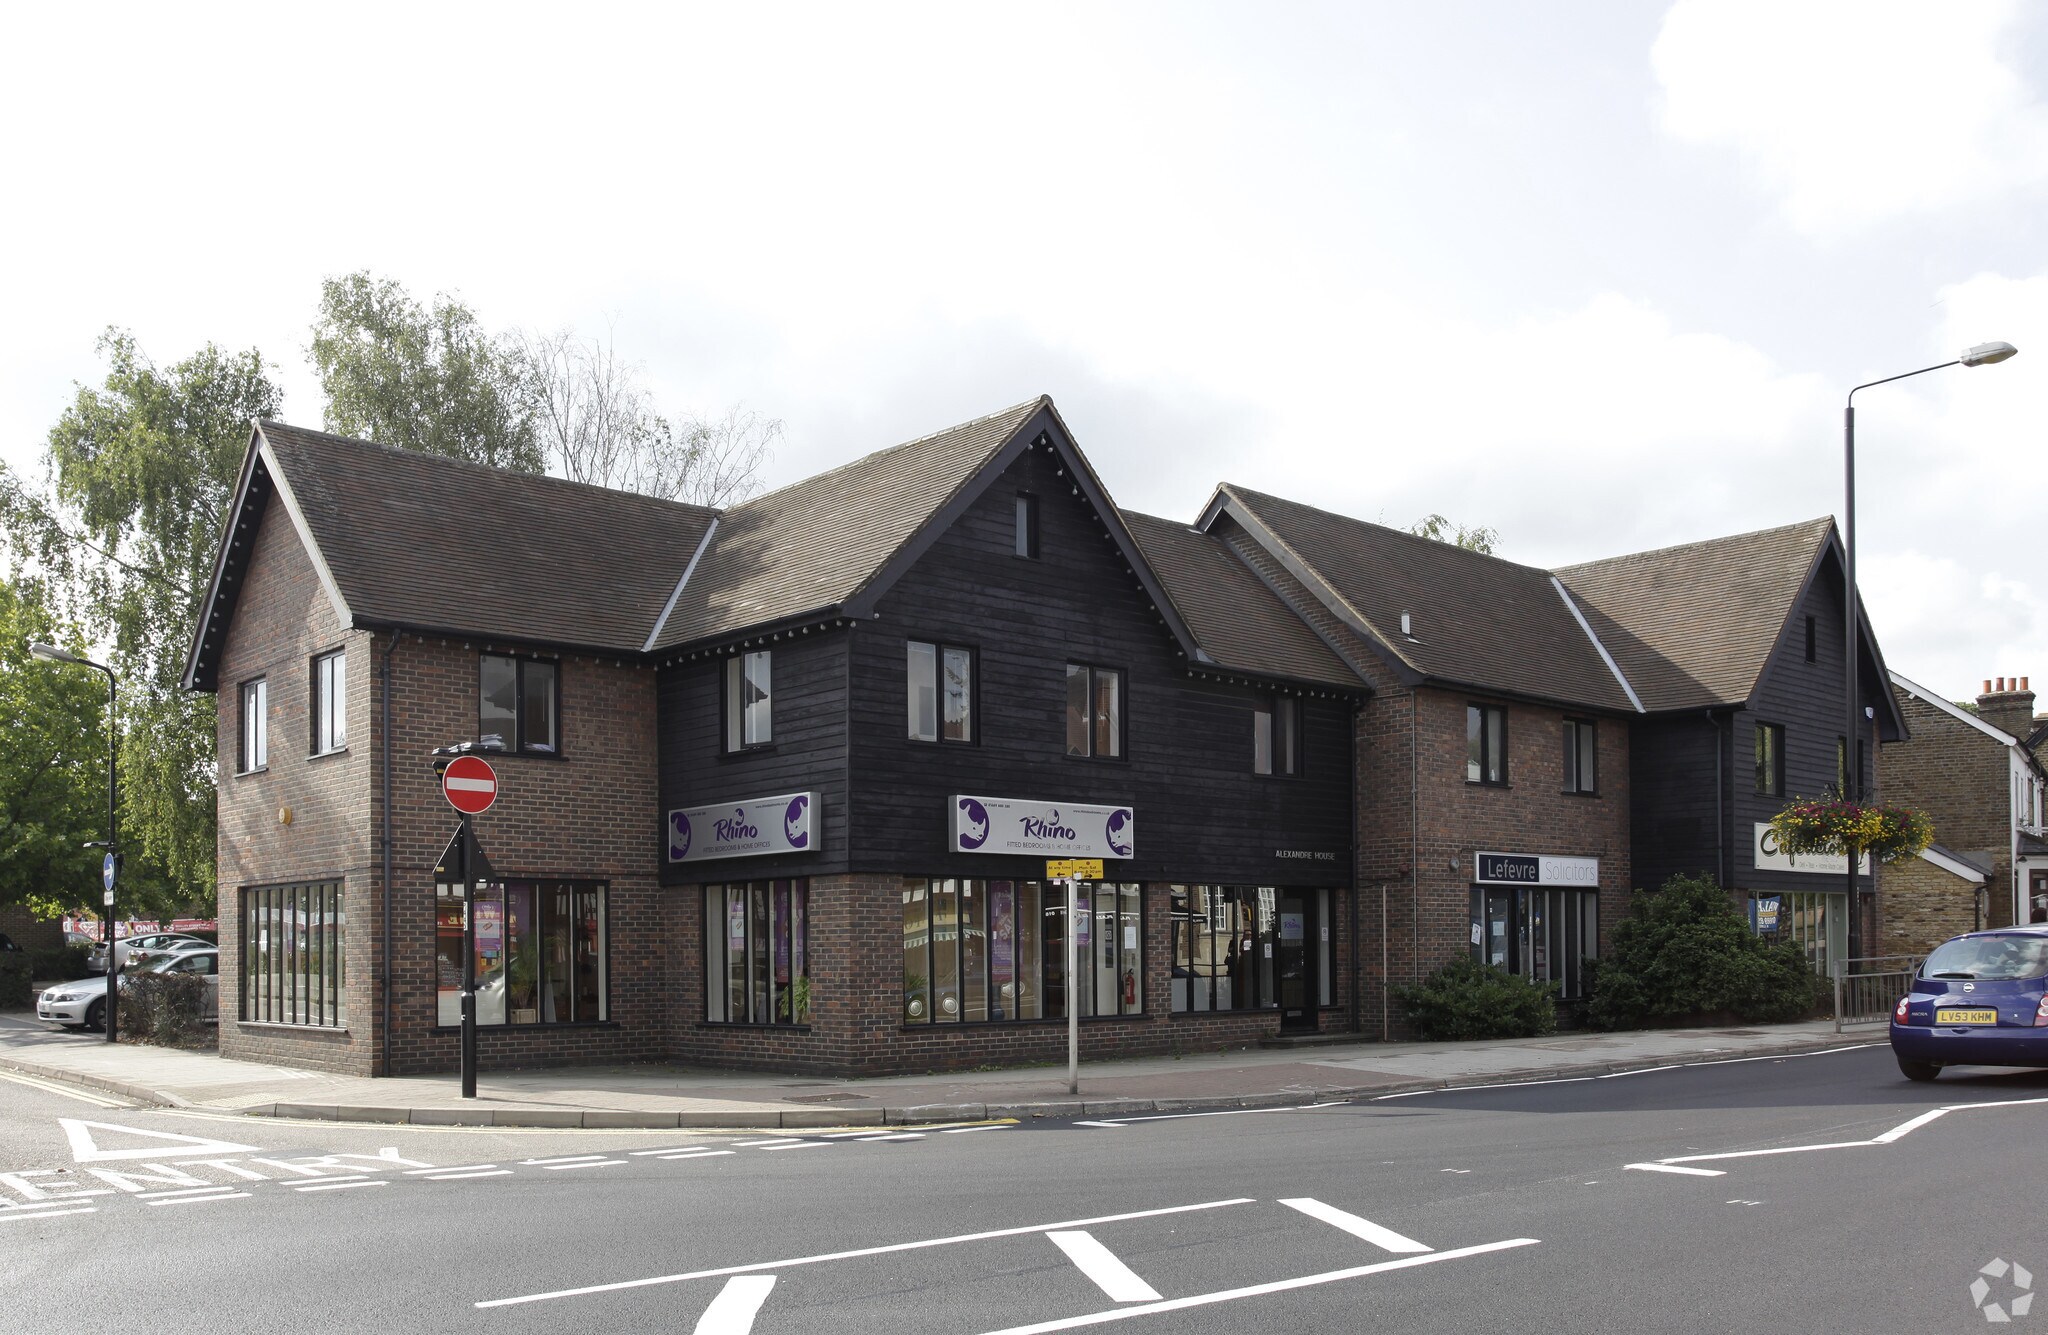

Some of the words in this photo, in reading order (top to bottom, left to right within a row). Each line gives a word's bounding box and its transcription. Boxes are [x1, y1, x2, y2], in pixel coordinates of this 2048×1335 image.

[713, 818, 758, 842] Rhino
[1019, 816, 1076, 840] Rhino
[715, 844, 737, 853] BEDROOMS
[741, 842, 754, 850] HOME
[754, 841, 771, 849] OFFICES
[1022, 842, 1051, 850] BEDROOMS
[1275, 850, 1312, 860] ALEXANDRE
[1314, 851, 1336, 861] HOUSE
[1488, 859, 1536, 879] Lefevre
[1545, 861, 1595, 881] Solicitors
[135, 924, 161, 933] ONLY
[1941, 1013, 1968, 1022] LV53
[1970, 1013, 1992, 1022] KHM
[0, 1147, 438, 1201] ENTRY
